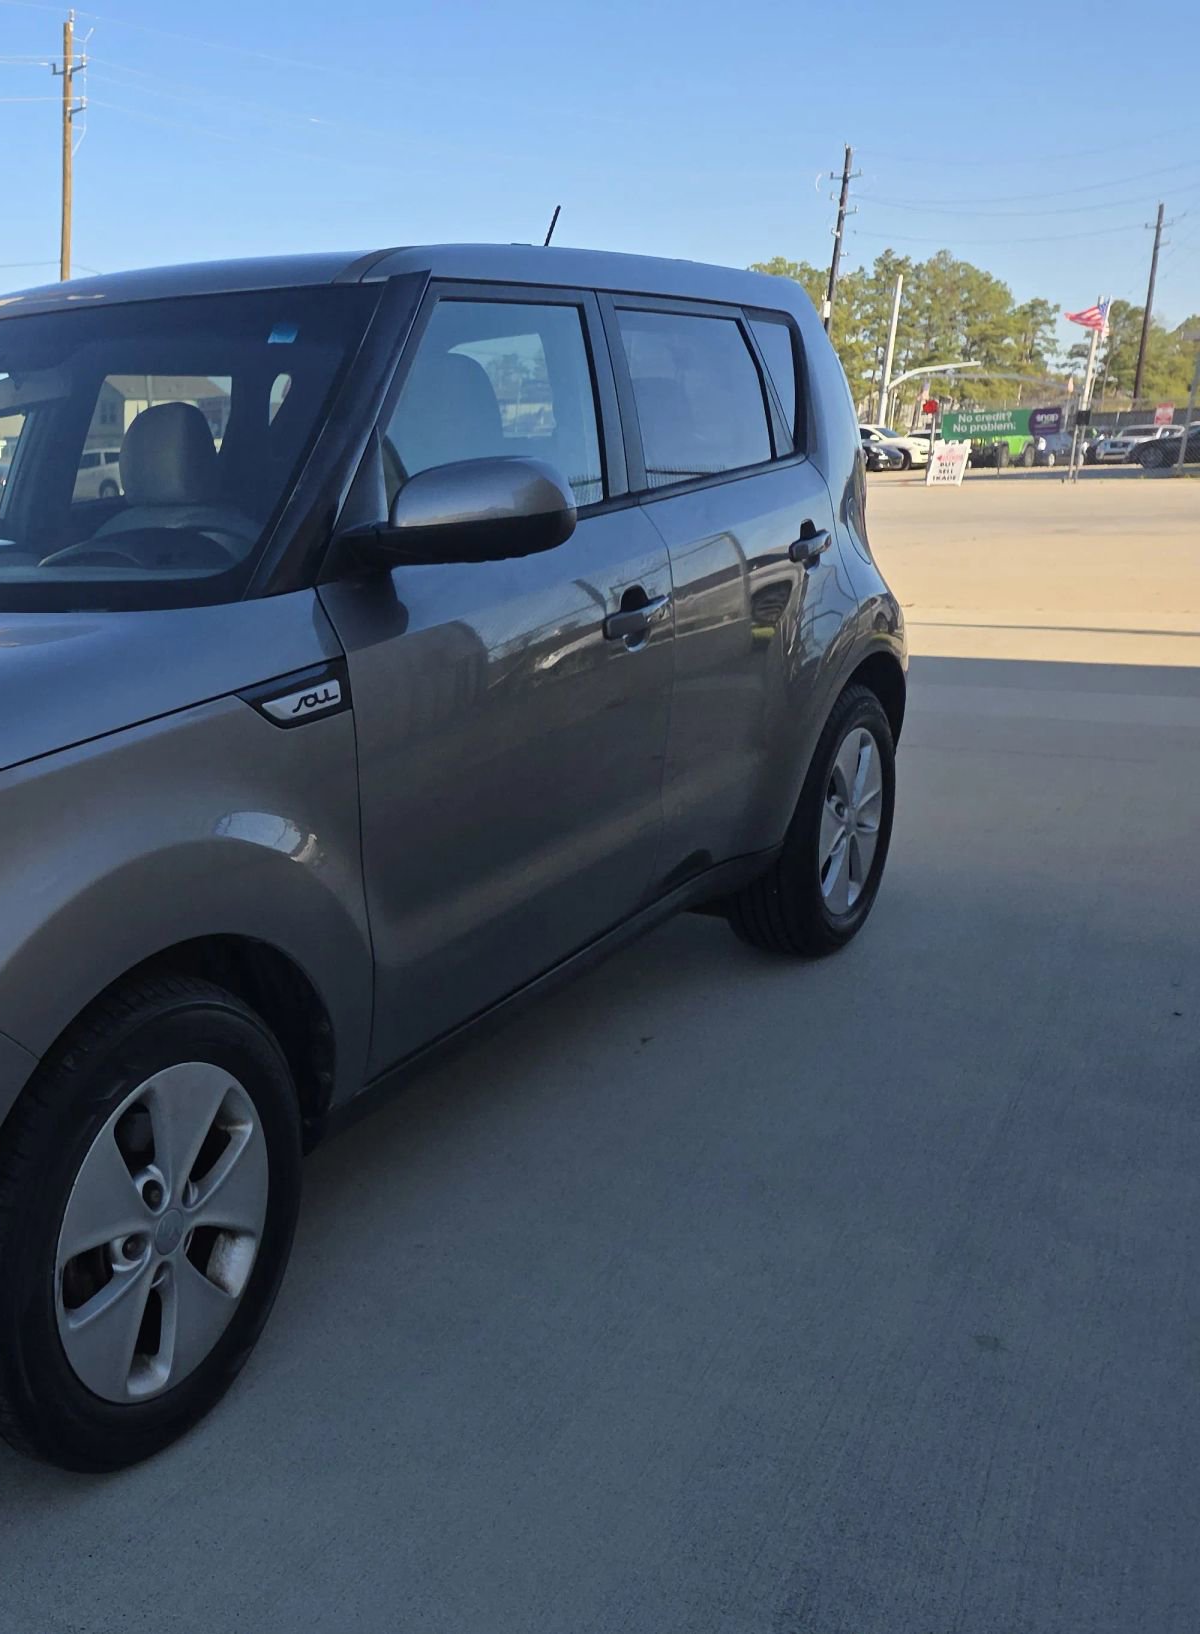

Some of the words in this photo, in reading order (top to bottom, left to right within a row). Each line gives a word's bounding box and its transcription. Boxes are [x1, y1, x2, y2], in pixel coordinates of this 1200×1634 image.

[958, 413, 973, 424] No
[975, 411, 1013, 422] credit?
[953, 423, 968, 433] No
